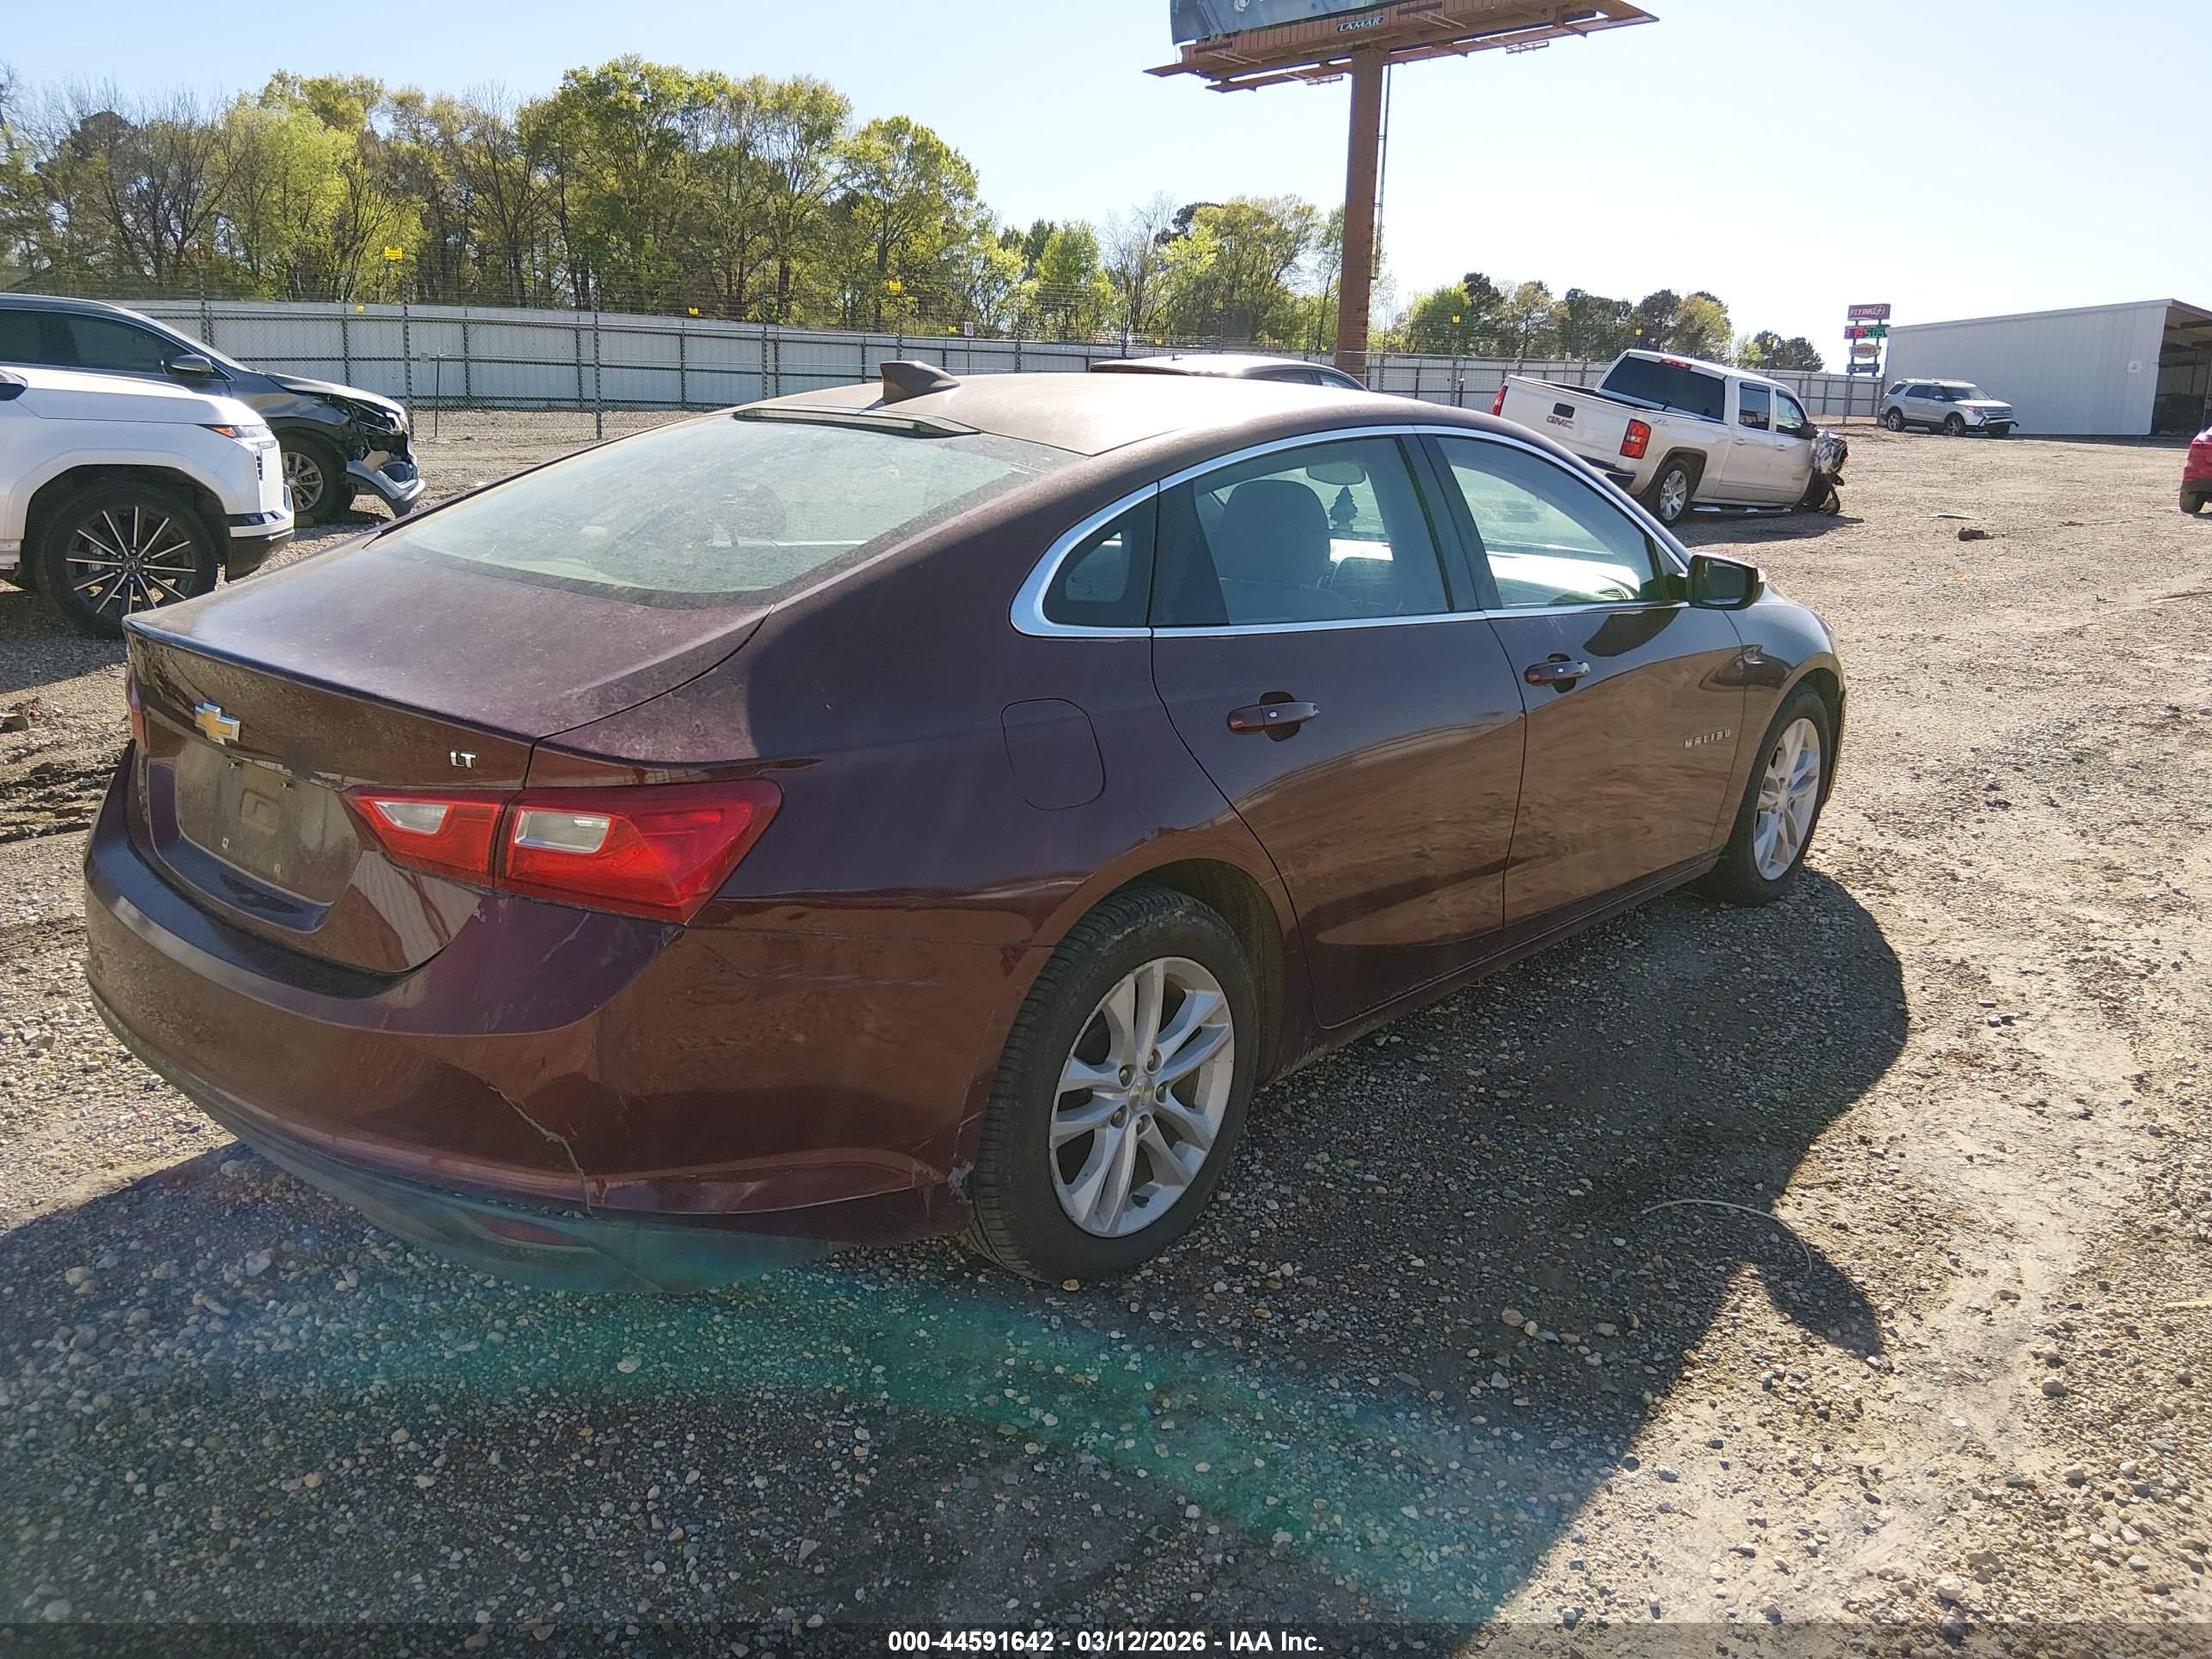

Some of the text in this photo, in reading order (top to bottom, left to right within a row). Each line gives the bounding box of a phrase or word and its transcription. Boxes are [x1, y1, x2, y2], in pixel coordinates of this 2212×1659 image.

[1340, 17, 1381, 32] LAMAR
[1850, 308, 1876, 317] FLYING
[1547, 416, 1574, 428] GMC
[1684, 728, 1731, 749] MALIBU
[450, 751, 477, 769] LT
